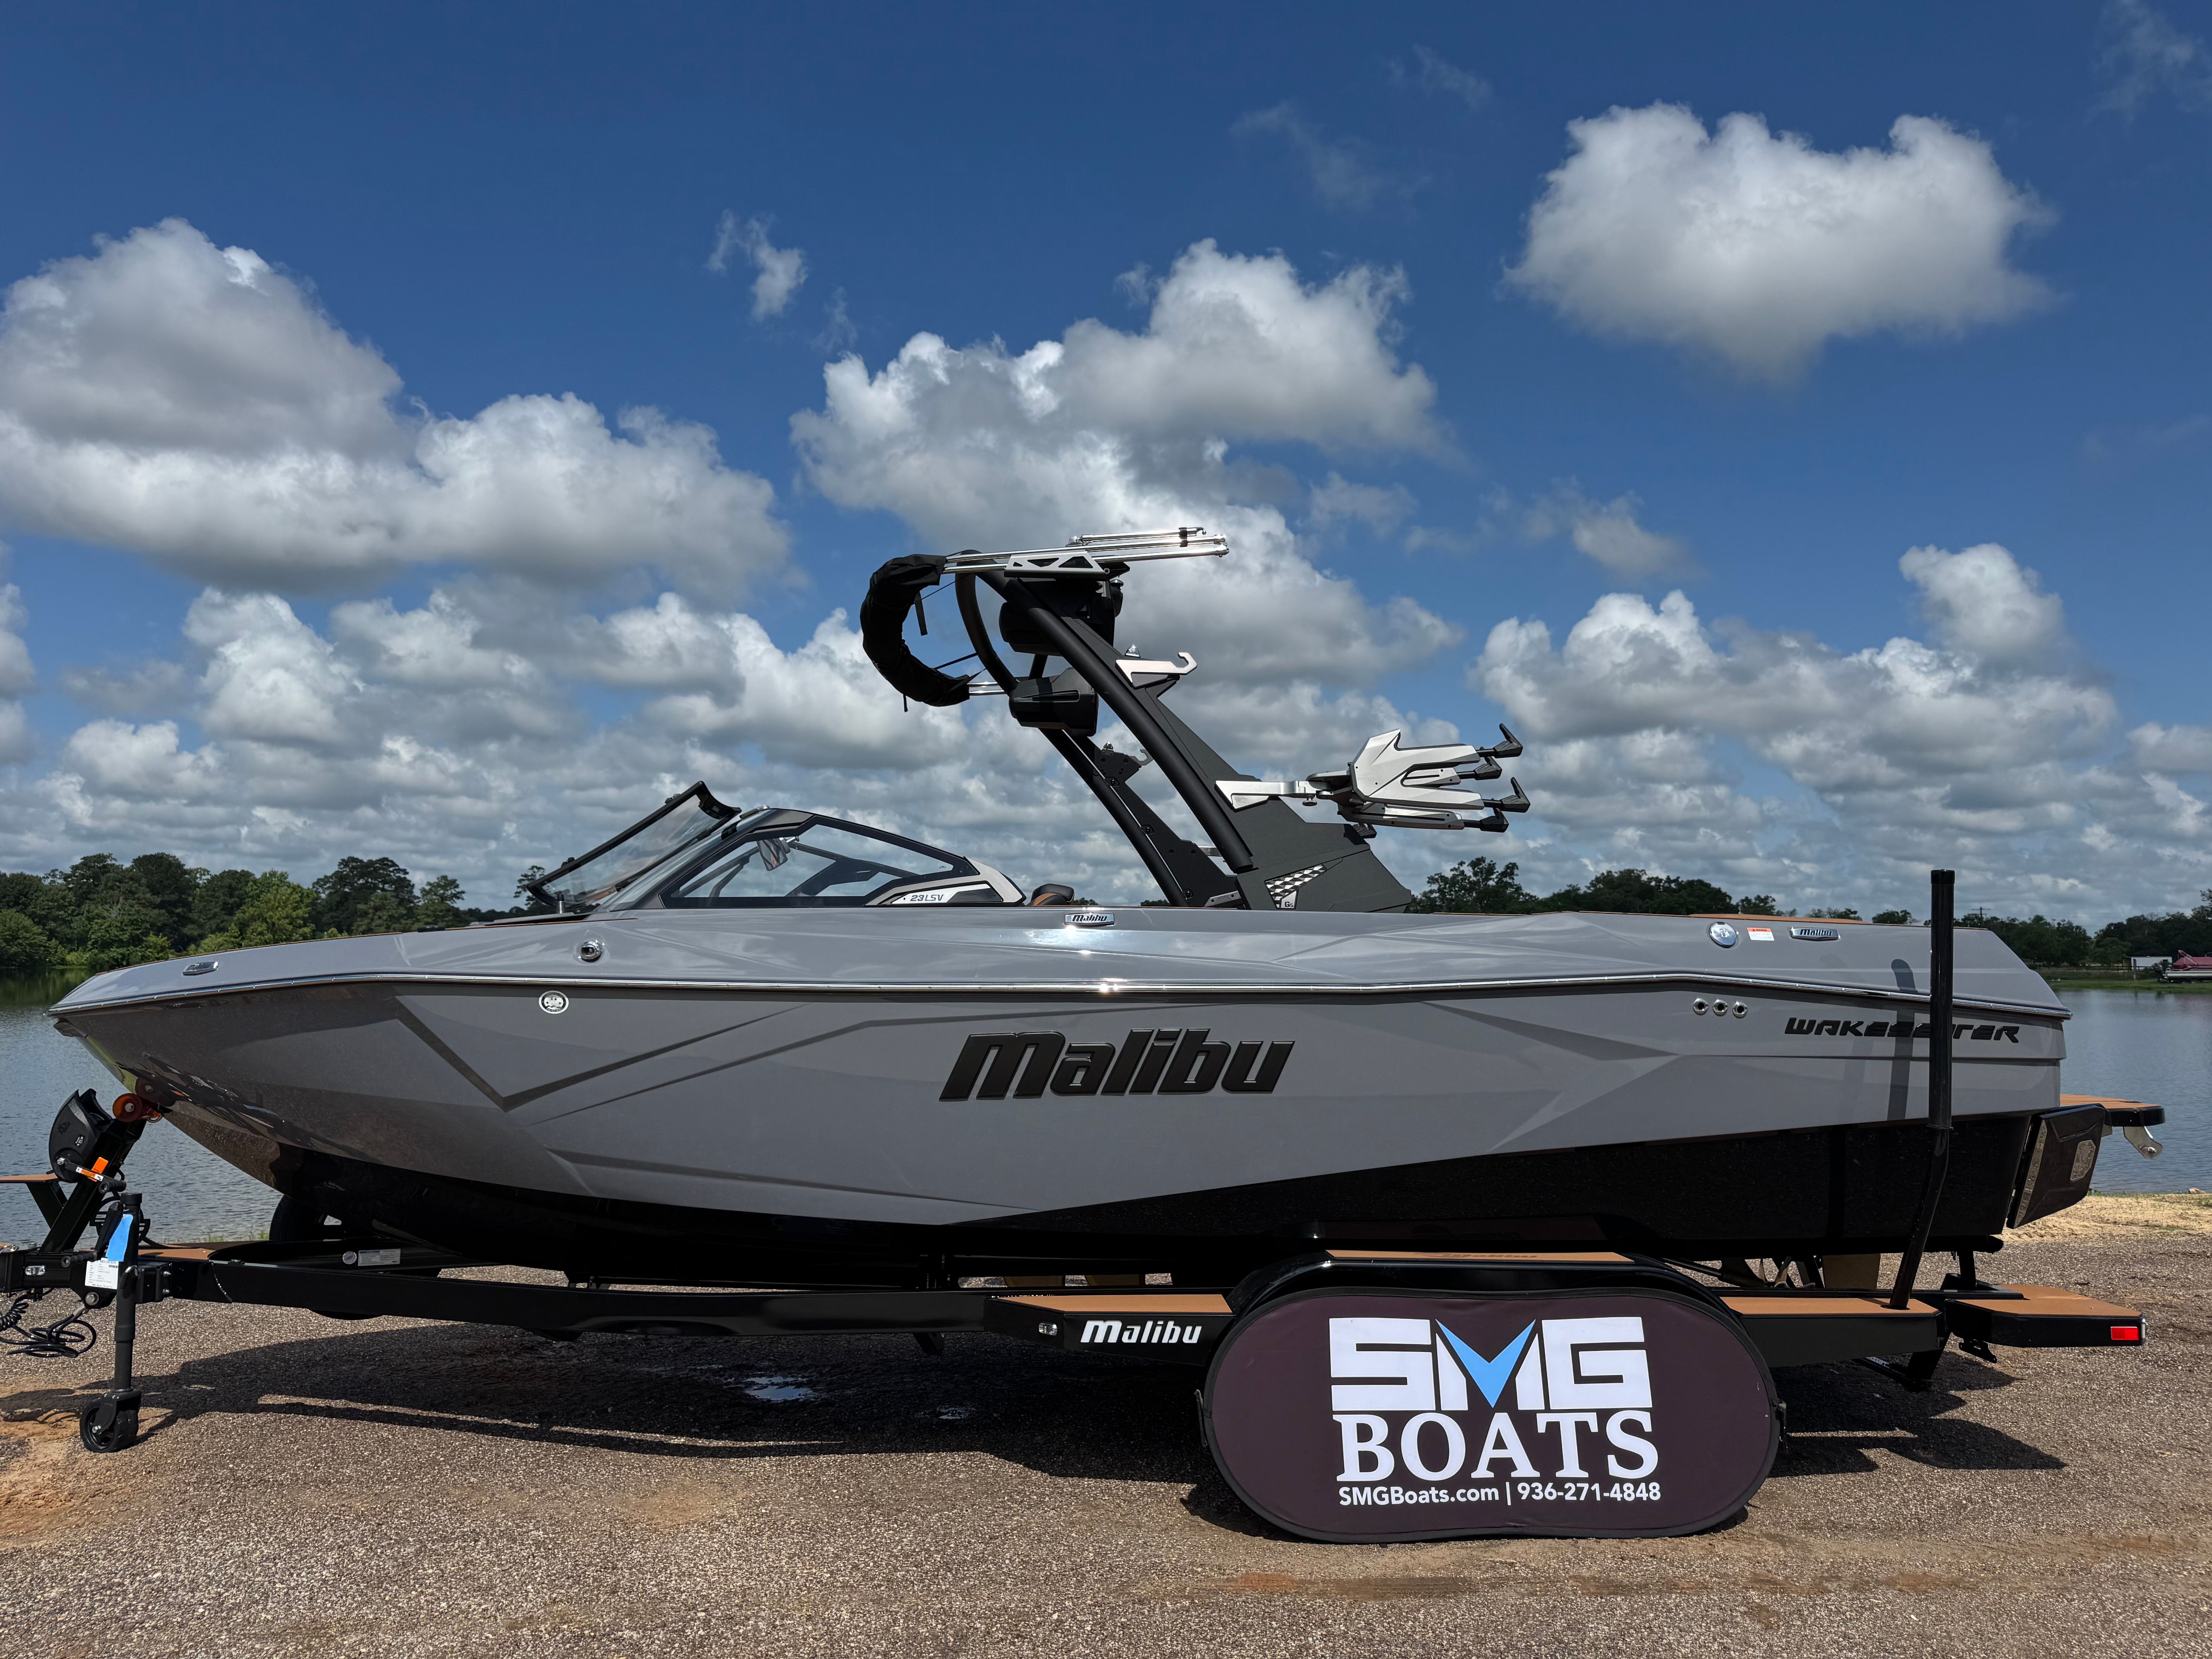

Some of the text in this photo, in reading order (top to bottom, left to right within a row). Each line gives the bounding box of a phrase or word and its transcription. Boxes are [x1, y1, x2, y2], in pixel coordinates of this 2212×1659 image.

[1784, 1017, 2020, 1043] WAKESETER
[939, 1027, 1295, 1102] Malibu
[1080, 1320, 1202, 1343] Malibu
[1329, 1317, 1652, 1411] SMG
[1332, 1410, 1658, 1482] BOATS
[1338, 1484, 1499, 1506] SMGBoats.com
[1517, 1482, 1661, 1501] 936-271-4848
